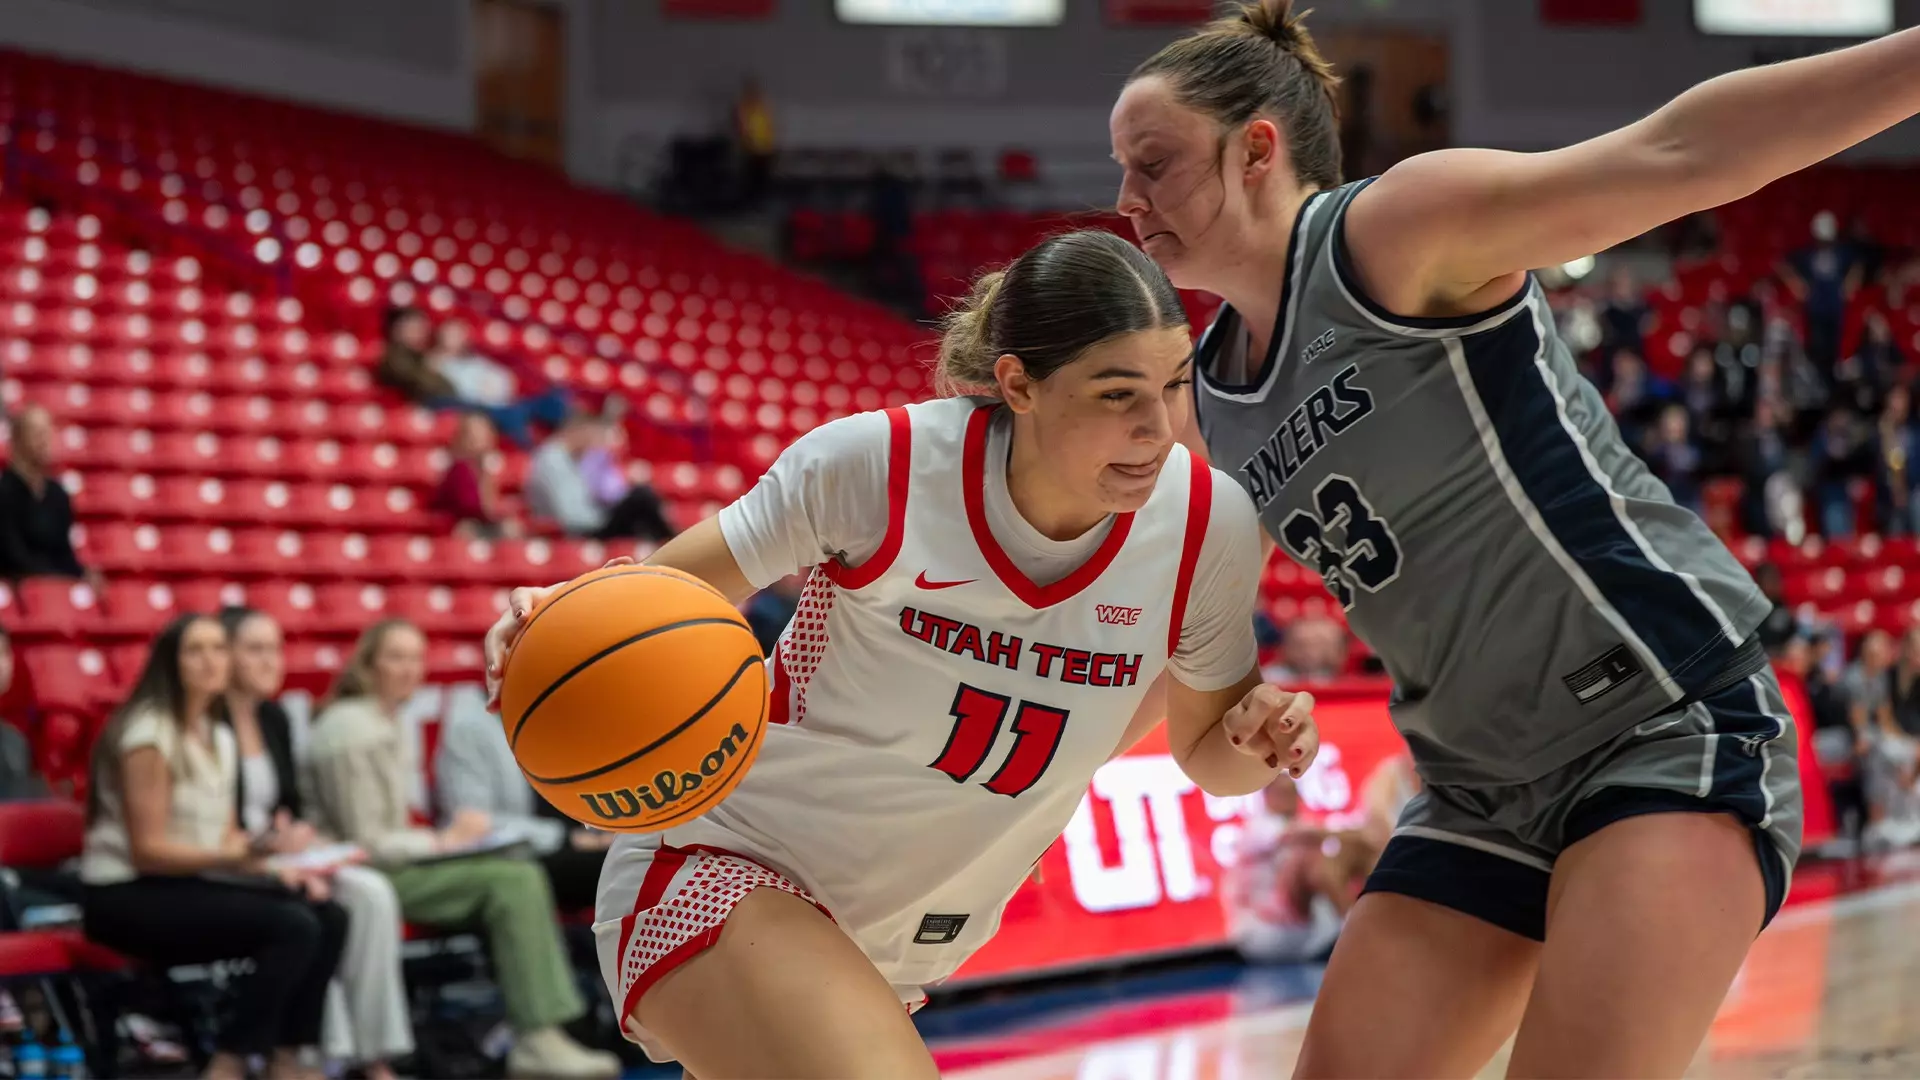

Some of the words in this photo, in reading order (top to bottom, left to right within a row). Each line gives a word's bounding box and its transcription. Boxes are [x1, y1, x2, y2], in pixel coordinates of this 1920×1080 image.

[1238, 362, 1376, 518] ANCERS
[1278, 472, 1404, 613] 33
[899, 606, 1023, 671] UTAH
[1029, 642, 1144, 687] TECH
[1096, 604, 1142, 626] WAC
[579, 722, 749, 820] Wilson
[926, 682, 1071, 799] 11
